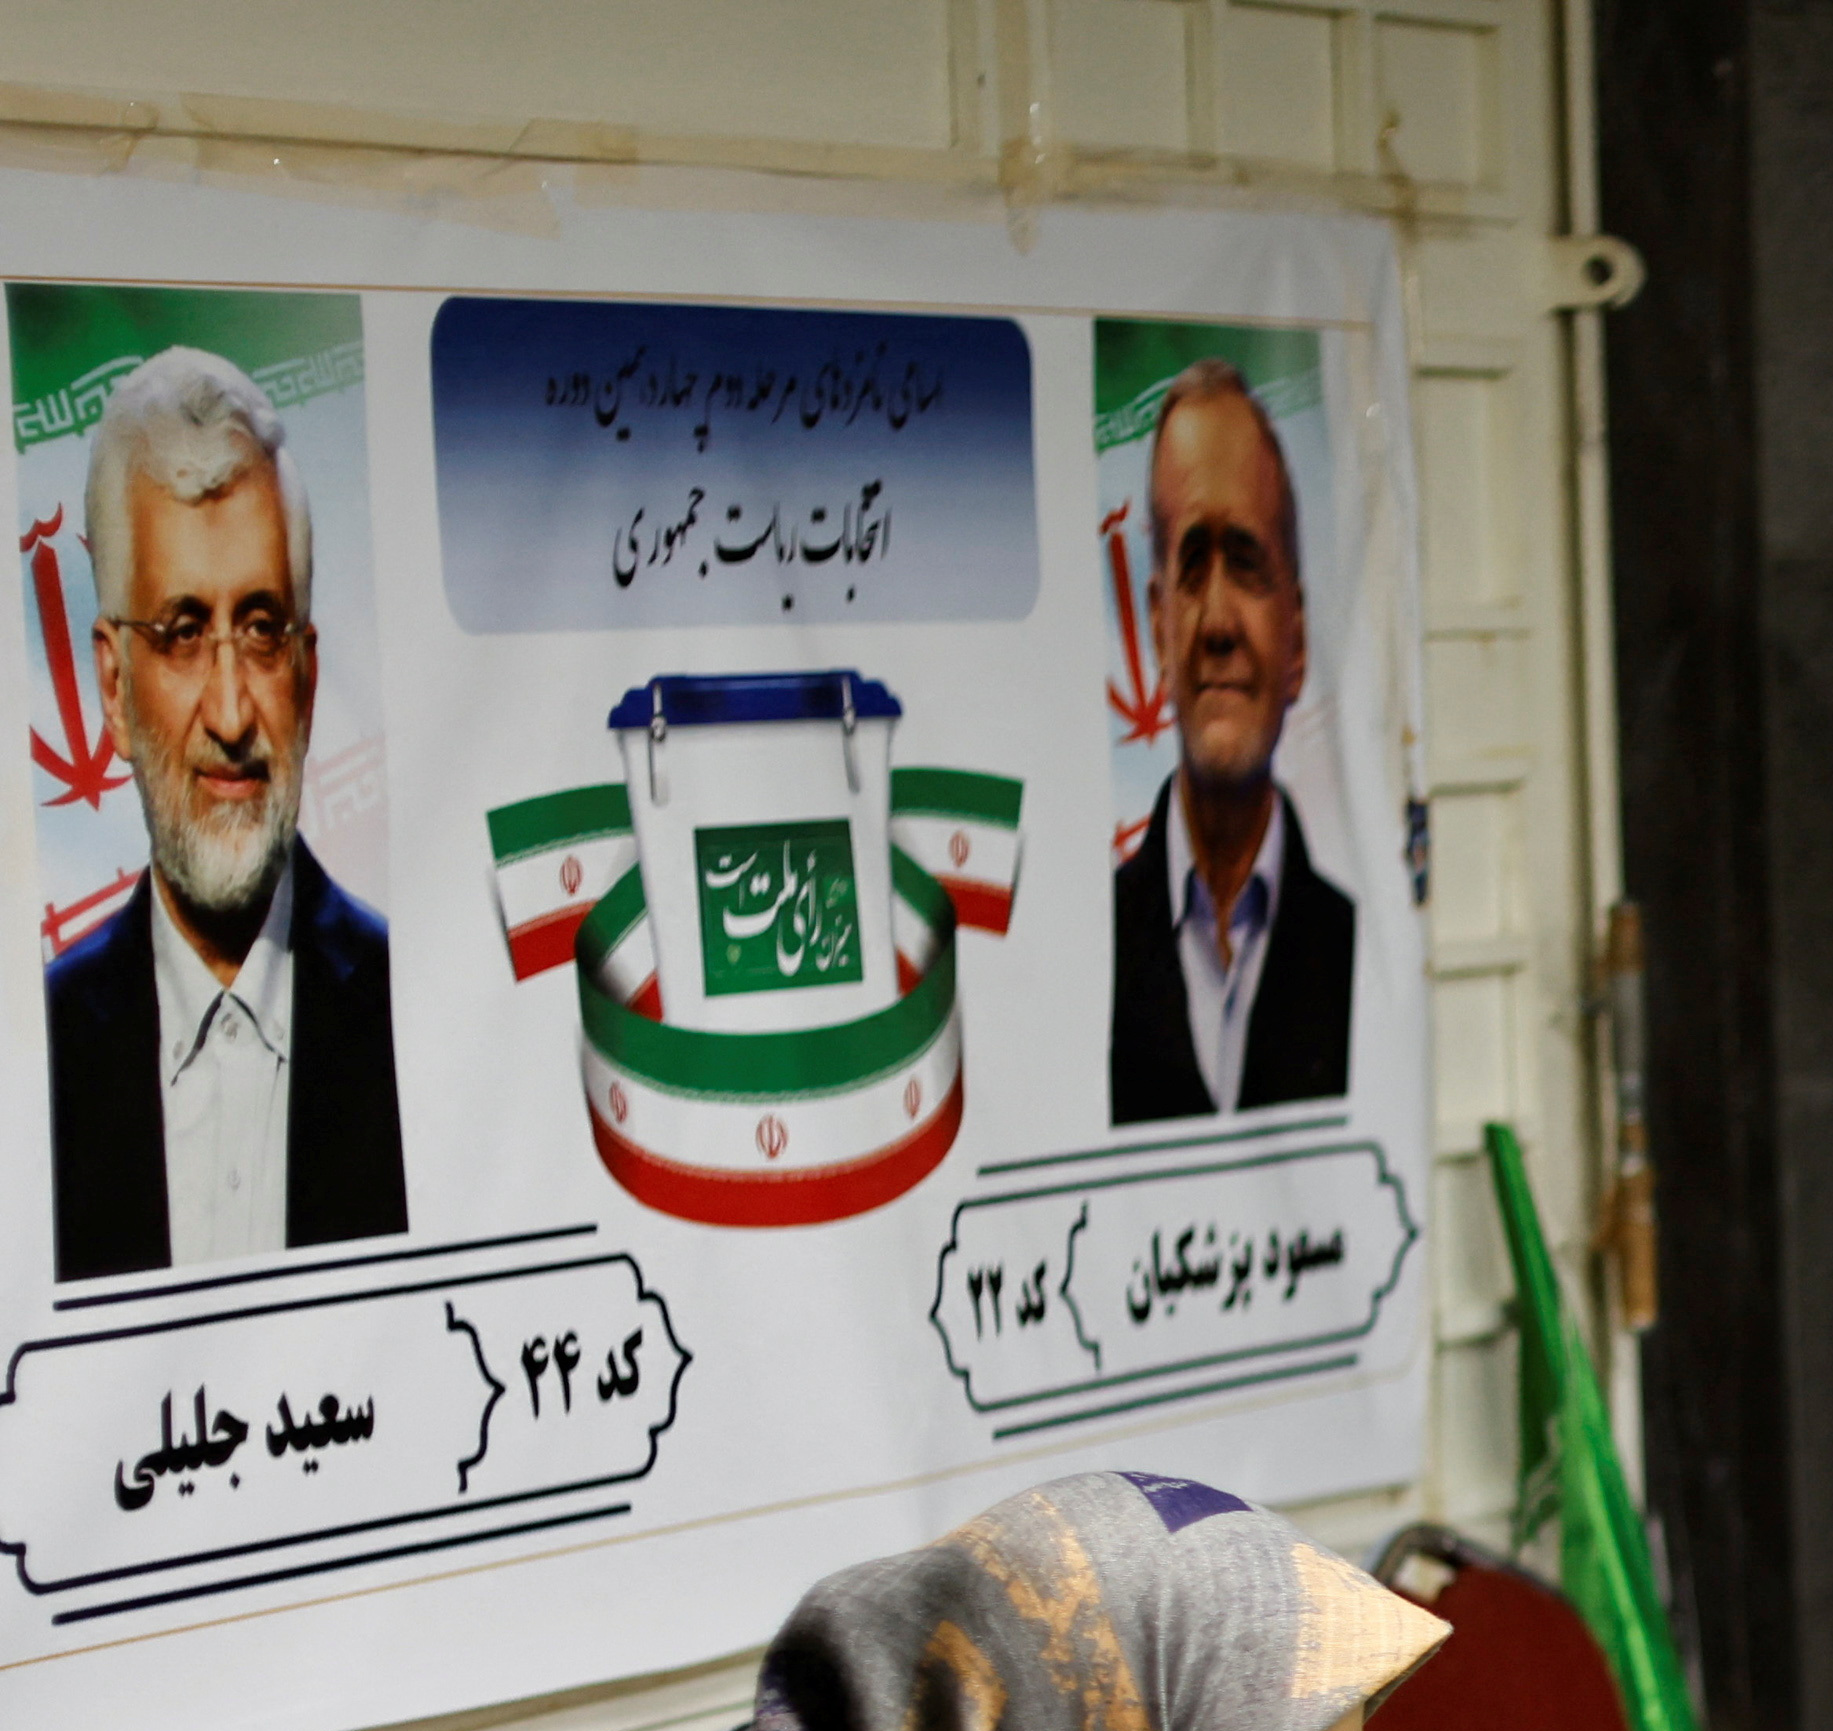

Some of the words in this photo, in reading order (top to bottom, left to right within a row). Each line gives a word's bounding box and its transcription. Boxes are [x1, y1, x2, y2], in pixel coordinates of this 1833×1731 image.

[543, 370, 592, 407] دوره
[746, 364, 798, 425] مرحله
[612, 486, 709, 588] جمهوری
[713, 500, 798, 612] ریاست
[800, 477, 893, 602] انتخابات
[722, 839, 798, 940] ملت
[966, 1263, 1004, 1342] ۲۲
[1015, 1258, 1048, 1328] کد
[1125, 1223, 1254, 1327] پزشکیان
[1262, 1227, 1346, 1302] مسعود
[520, 1330, 582, 1419] ۴۴
[597, 1328, 644, 1403] کد
[113, 1383, 250, 1512] جلیلی
[265, 1391, 376, 1475] سعید
